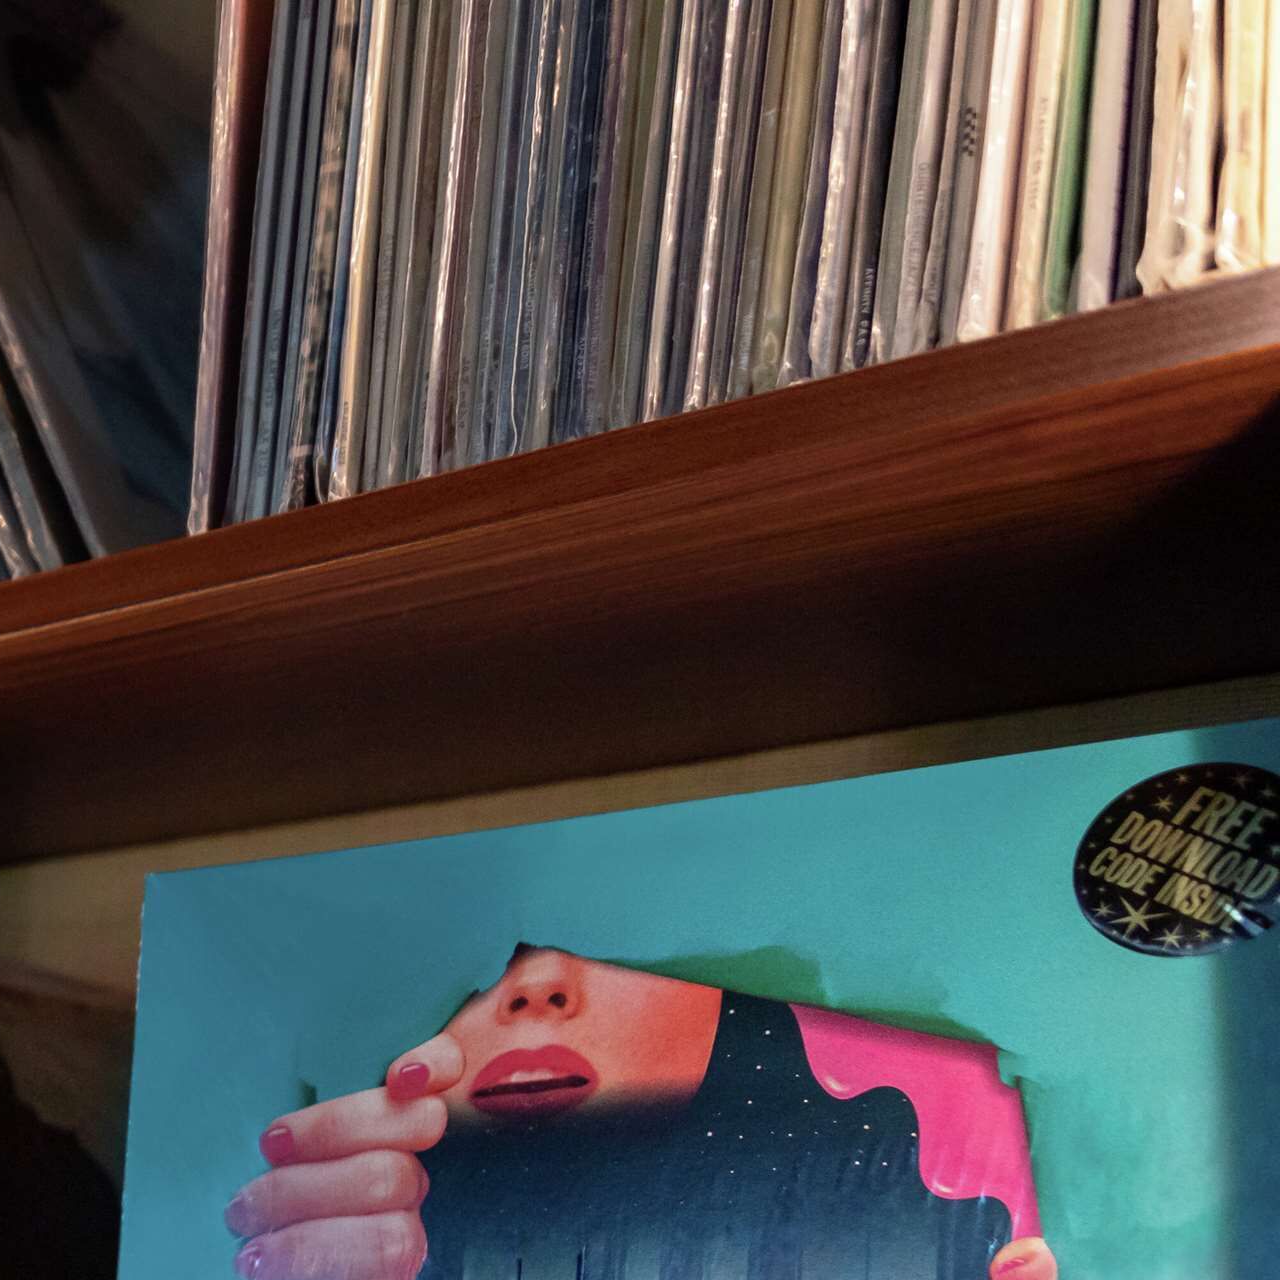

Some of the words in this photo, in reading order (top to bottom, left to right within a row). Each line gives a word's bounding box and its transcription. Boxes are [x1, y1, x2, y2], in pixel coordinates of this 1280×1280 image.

[1171, 786, 1277, 849] FREE
[1089, 847, 1165, 895] CODE
[1109, 811, 1279, 898] DOWNLOAD
